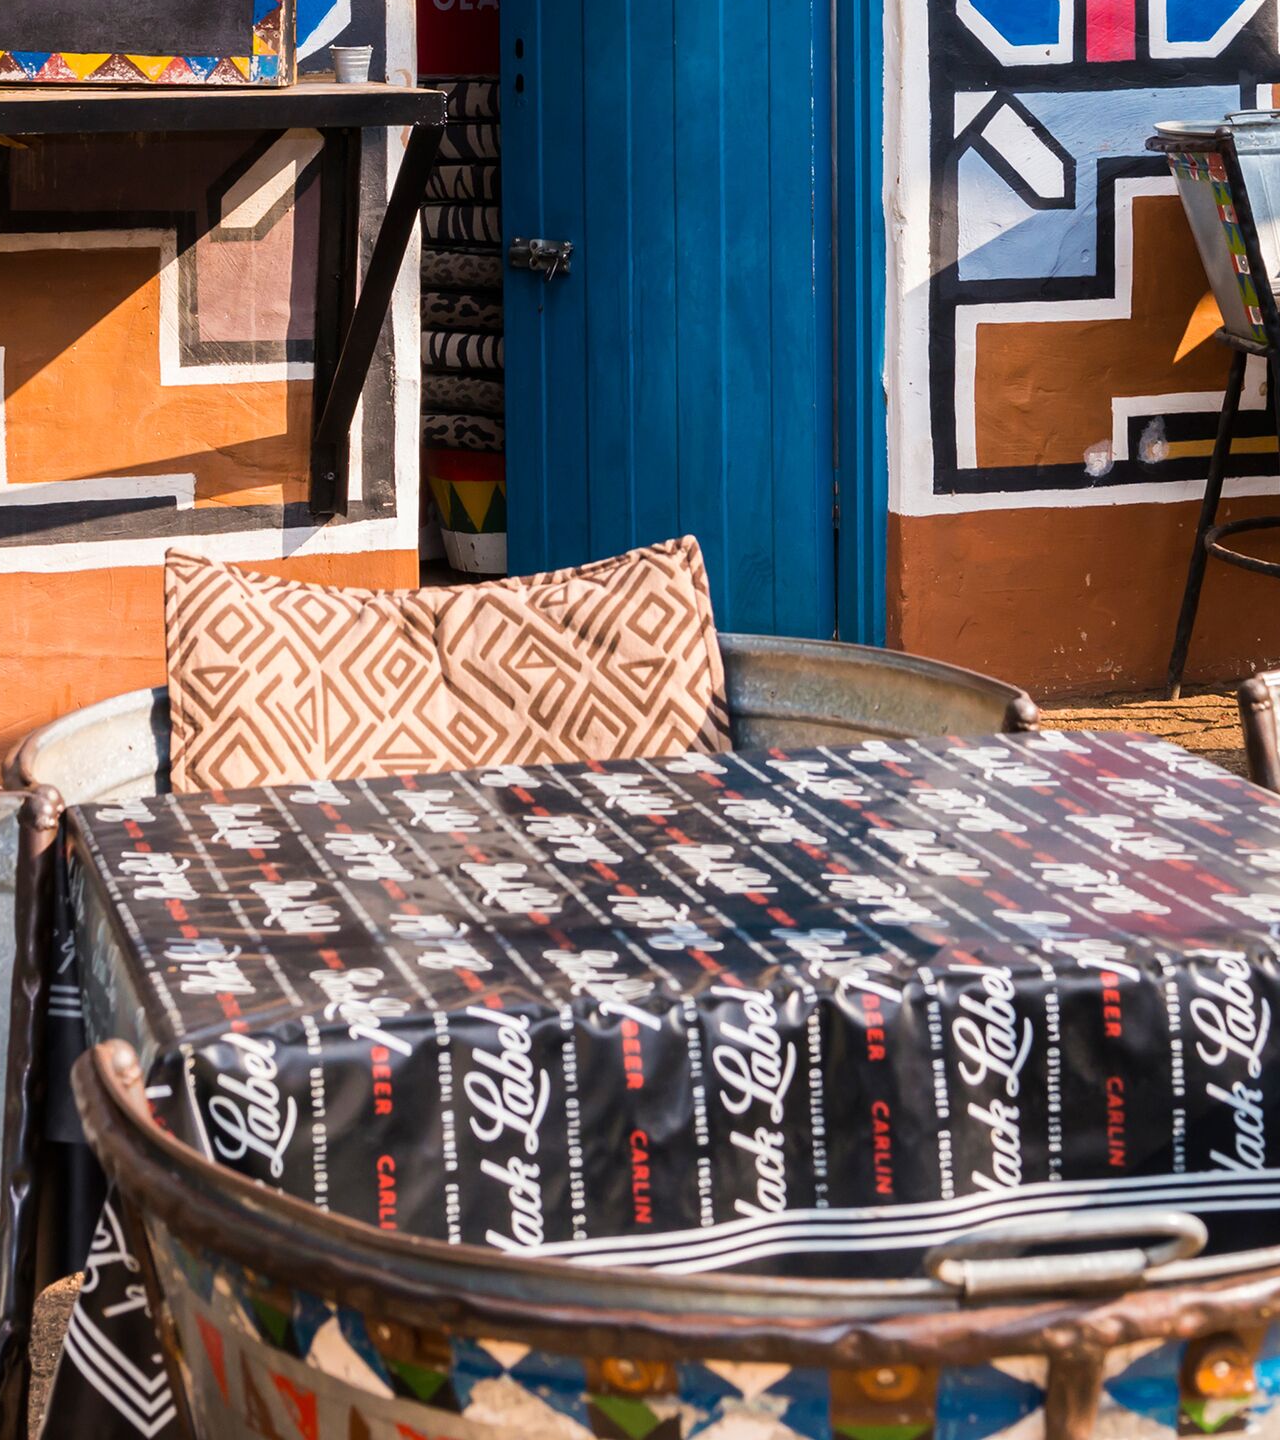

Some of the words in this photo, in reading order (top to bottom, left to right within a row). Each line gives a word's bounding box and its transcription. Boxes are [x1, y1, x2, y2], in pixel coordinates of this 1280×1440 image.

[621, 1019, 644, 1089] BEER
[710, 986, 797, 1124] Label
[861, 993, 886, 1061] BEER
[948, 964, 1033, 1098] Label
[1100, 971, 1122, 1037] BEER
[1183, 949, 1271, 1079] Label
[209, 1033, 297, 1178] Label
[371, 1046, 393, 1115] BEER
[463, 1006, 550, 1155] Label
